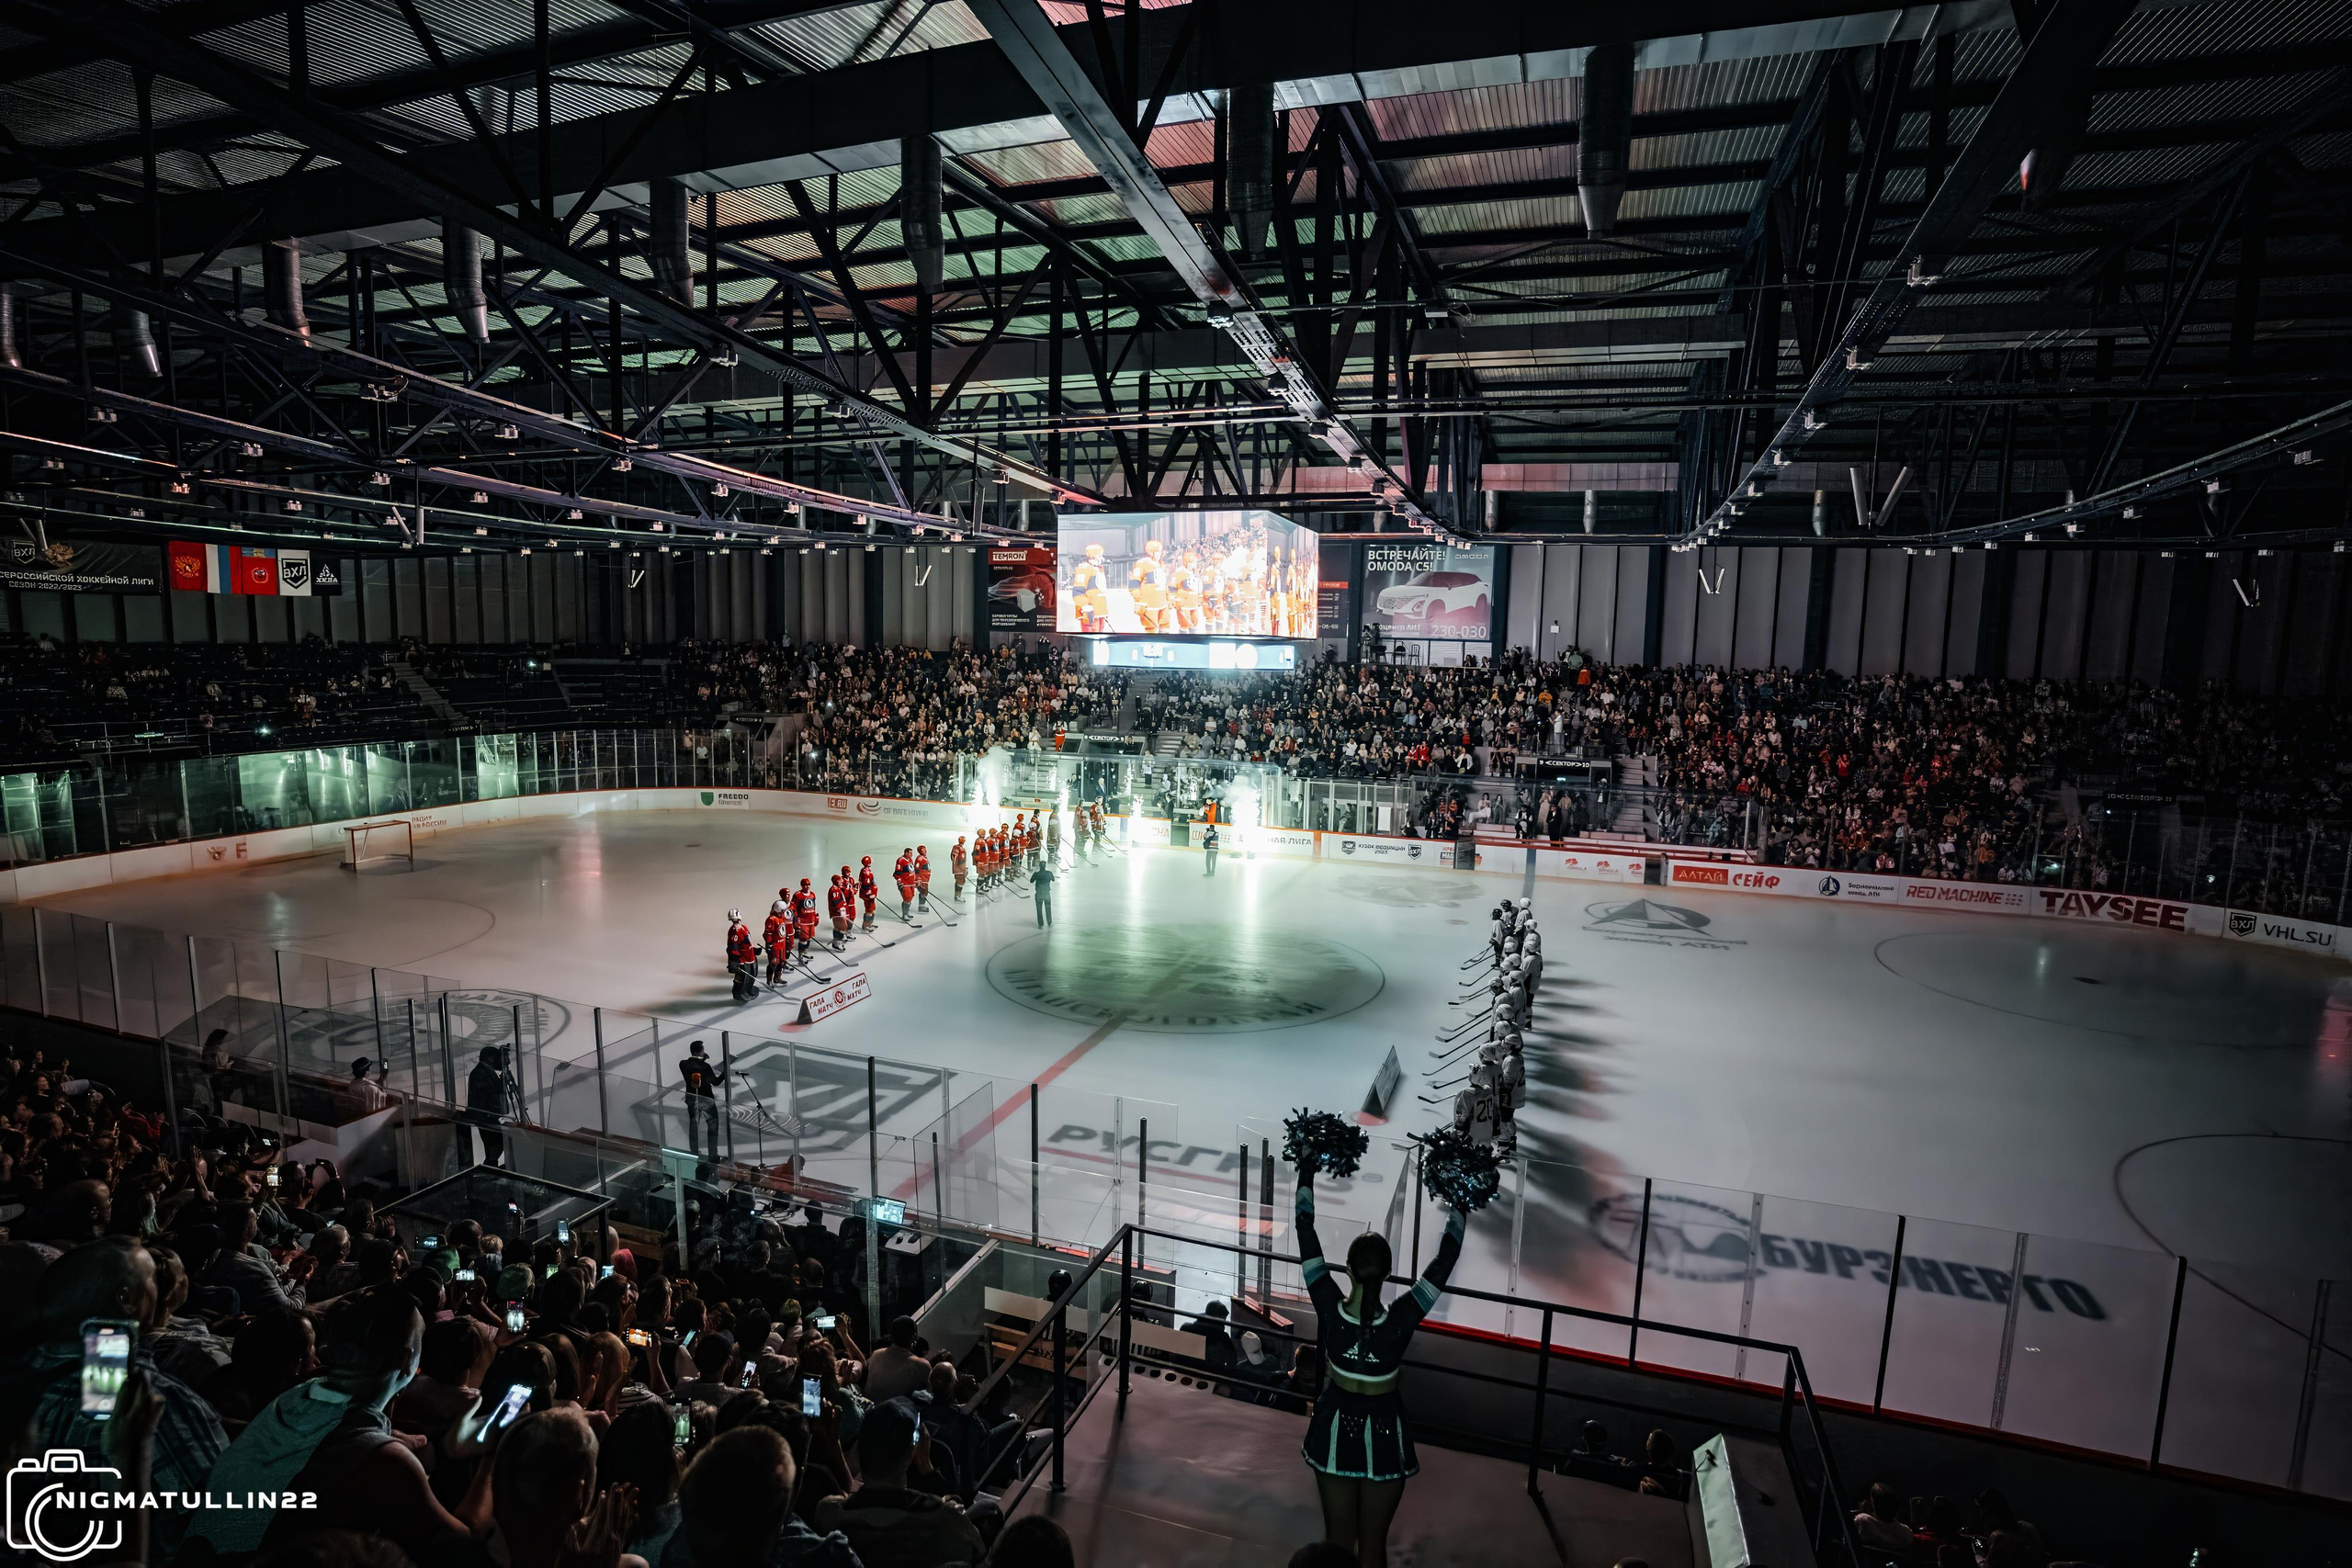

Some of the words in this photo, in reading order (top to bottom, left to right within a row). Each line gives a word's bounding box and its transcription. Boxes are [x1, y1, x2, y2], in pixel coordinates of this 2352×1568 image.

[1368, 547, 1445, 560] ВСТРЕЧАЙТЕ!
[283, 565, 307, 579] ВХЛ
[1367, 562, 1413, 571] OMODA
[1430, 625, 1487, 638] 230-030
[1287, 837, 1312, 846] ЛИГА
[1732, 871, 1781, 888] СЕЙФ
[1906, 886, 1936, 899] RED
[1937, 886, 2004, 904] MACHINE
[2039, 890, 2189, 931] TAYSEE
[2231, 920, 2254, 929] ВХЛ
[852, 978, 866, 990] ГАЛА
[847, 989, 862, 1000] МАТЧ
[808, 998, 825, 1009] ГАЛА
[818, 1002, 833, 1015] МАТЧ
[1759, 1234, 2107, 1321] БУРЭНЕРГО
